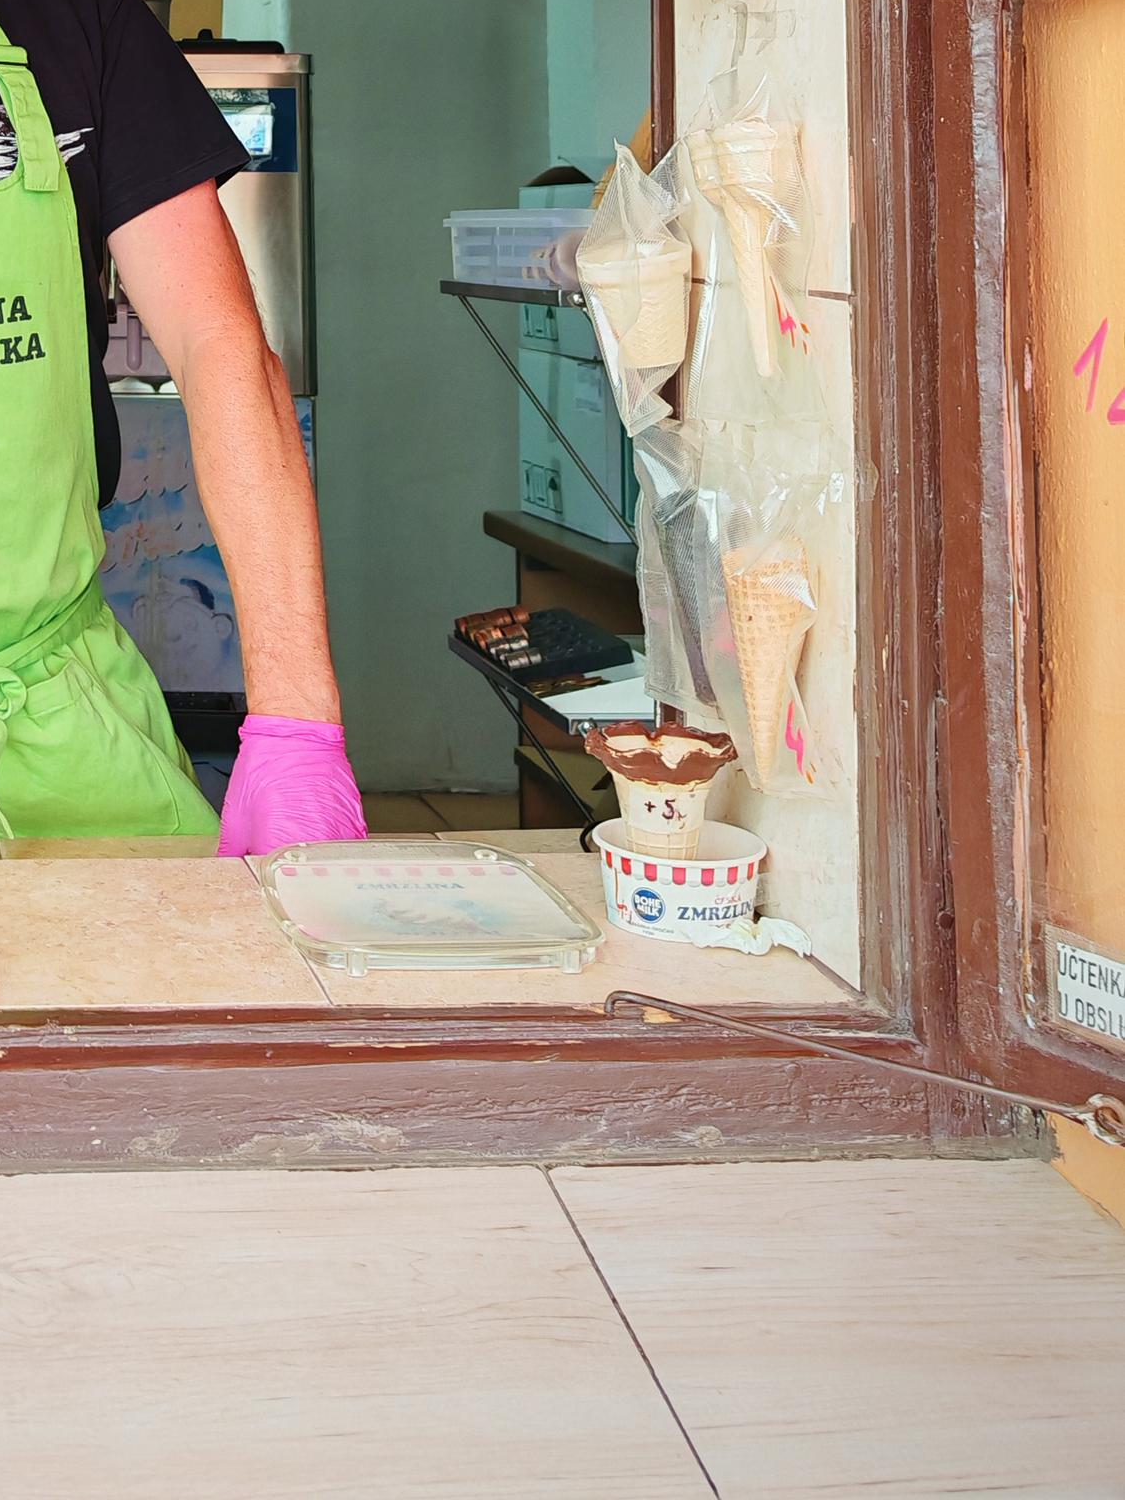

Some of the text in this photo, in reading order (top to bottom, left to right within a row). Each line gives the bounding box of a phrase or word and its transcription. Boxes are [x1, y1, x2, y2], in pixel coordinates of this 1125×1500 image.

[634, 893, 664, 910] BOHE
[636, 901, 661, 918] MILK
[1059, 992, 1068, 1017] U
